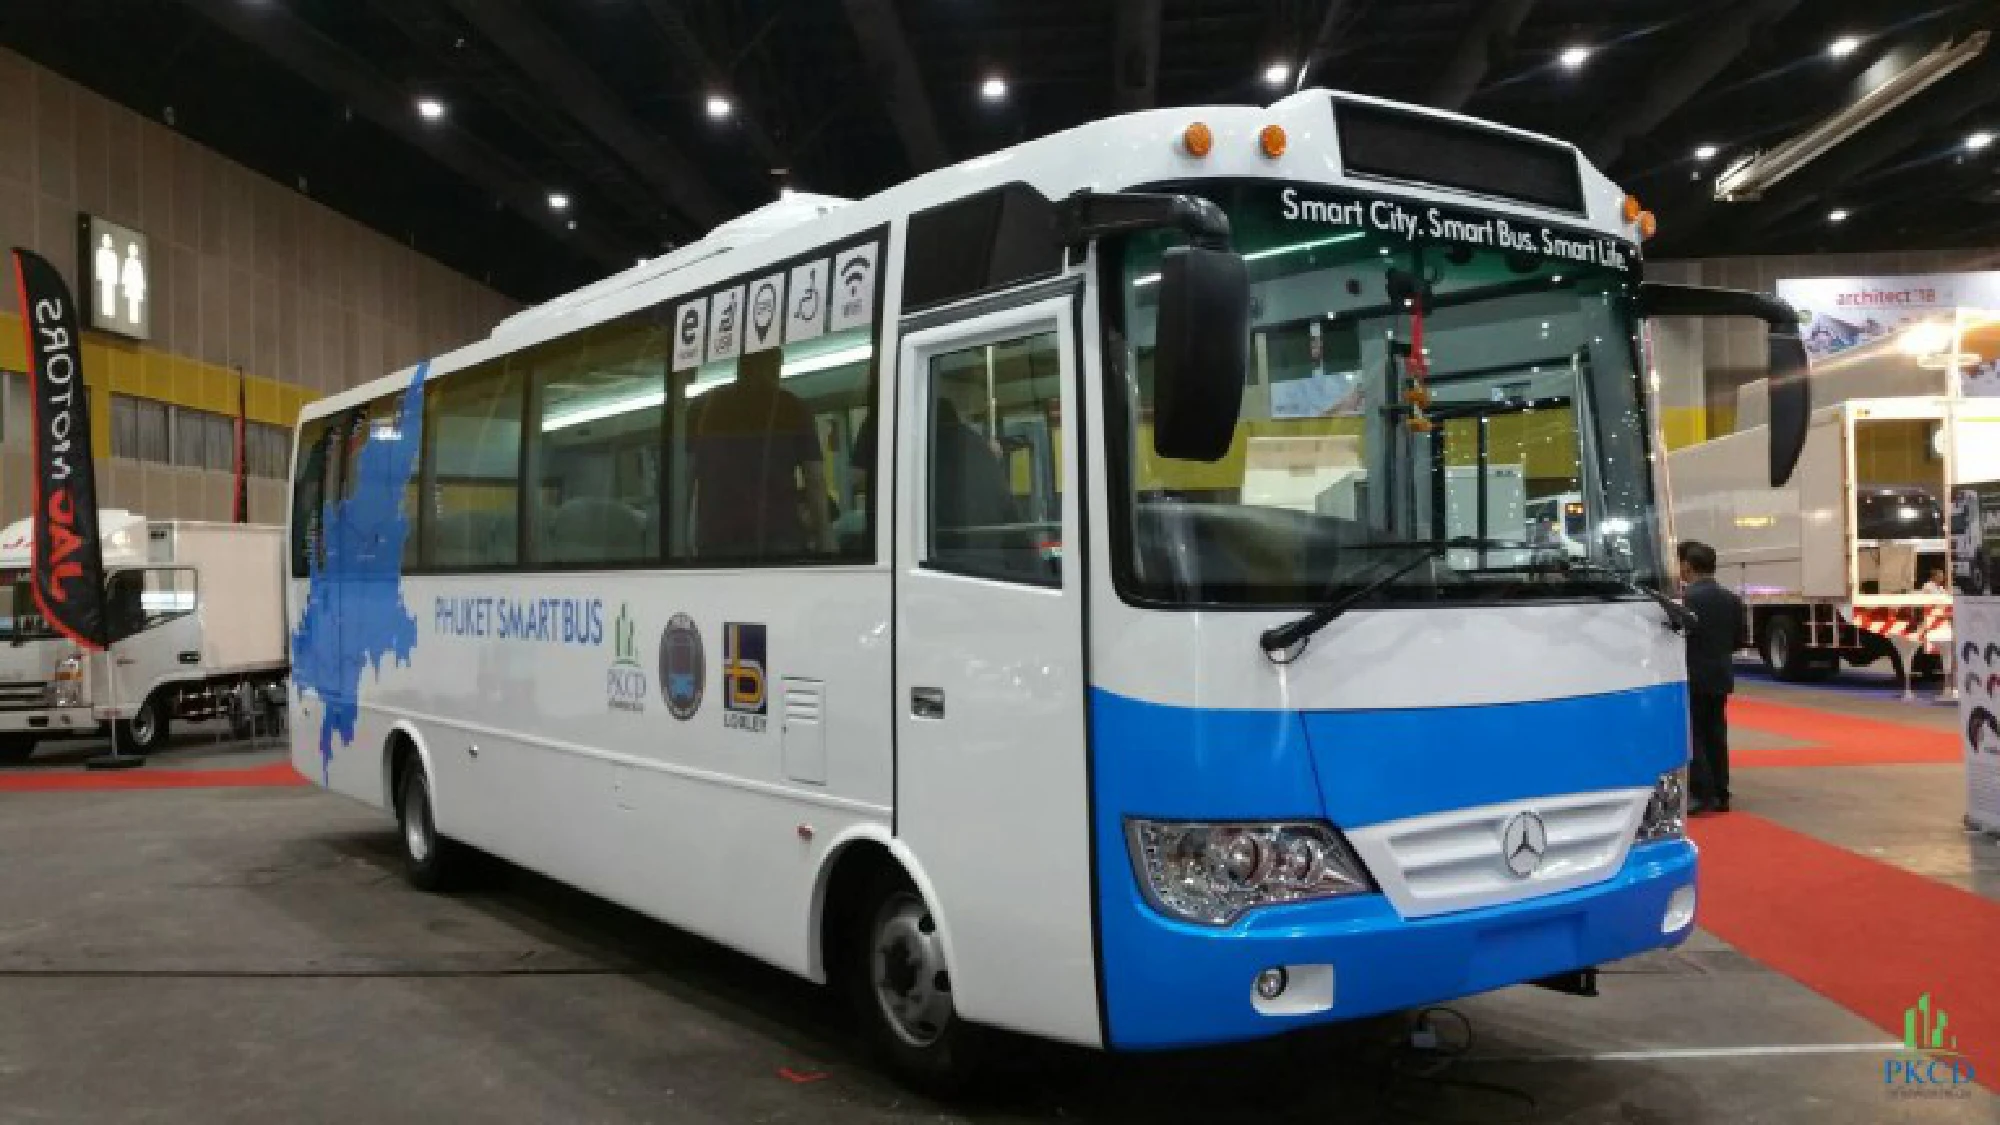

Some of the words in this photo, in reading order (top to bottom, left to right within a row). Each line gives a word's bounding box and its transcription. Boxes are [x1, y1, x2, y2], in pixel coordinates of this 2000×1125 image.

[1281, 187, 1363, 225] Smart
[1370, 200, 1424, 241] City.
[1429, 208, 1493, 246] Smart
[1499, 220, 1538, 252] Bus.
[1541, 228, 1595, 263] Smart
[1836, 288, 1911, 306] architect
[435, 595, 492, 636] PHUKET
[497, 597, 561, 642] SMART
[562, 597, 603, 646] BUS
[606, 668, 647, 703] PKCD
